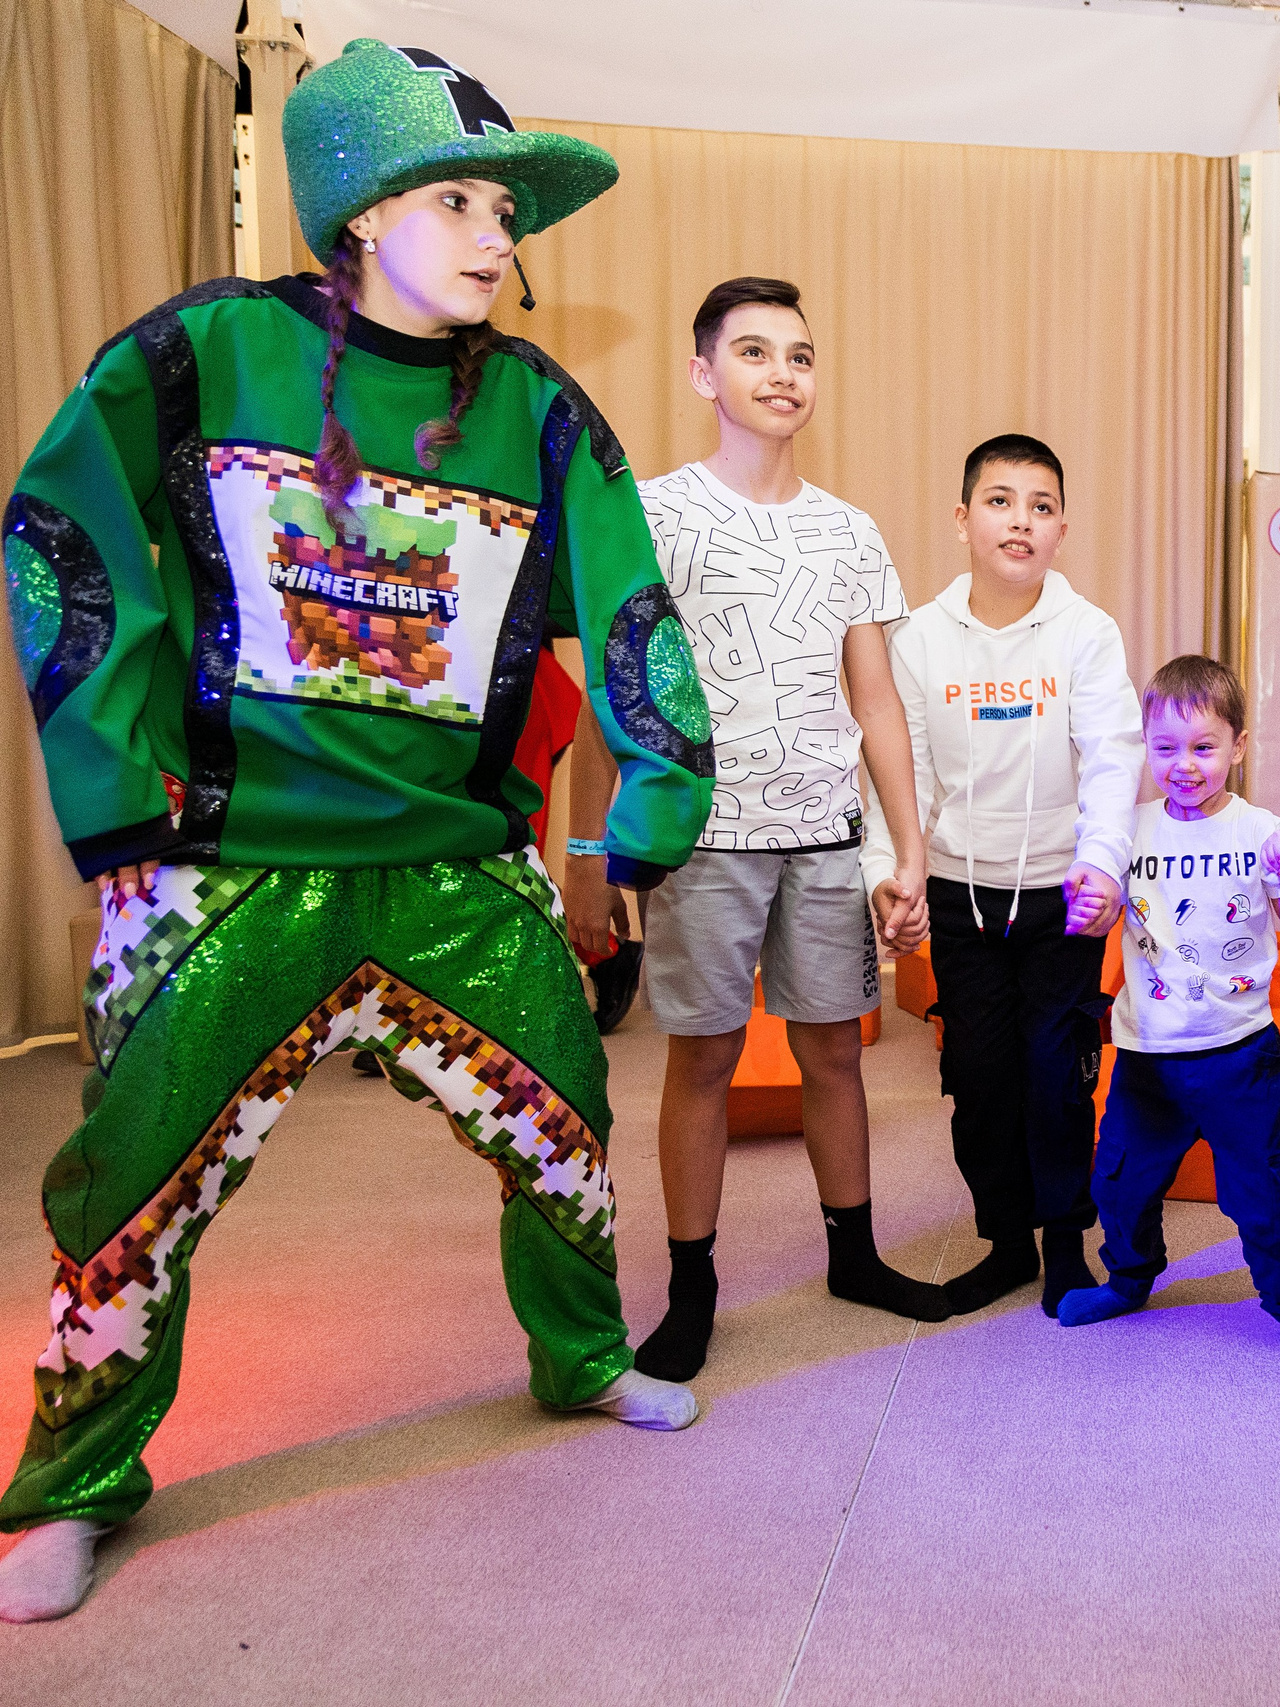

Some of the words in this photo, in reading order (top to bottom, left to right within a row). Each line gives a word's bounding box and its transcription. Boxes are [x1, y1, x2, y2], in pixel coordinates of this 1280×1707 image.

[268, 560, 459, 622] MINECRAFT
[944, 676, 1058, 705] PERSON
[980, 708, 1008, 720] PERSON
[1009, 705, 1033, 719] SHINE
[1080, 1049, 1102, 1083] LA
